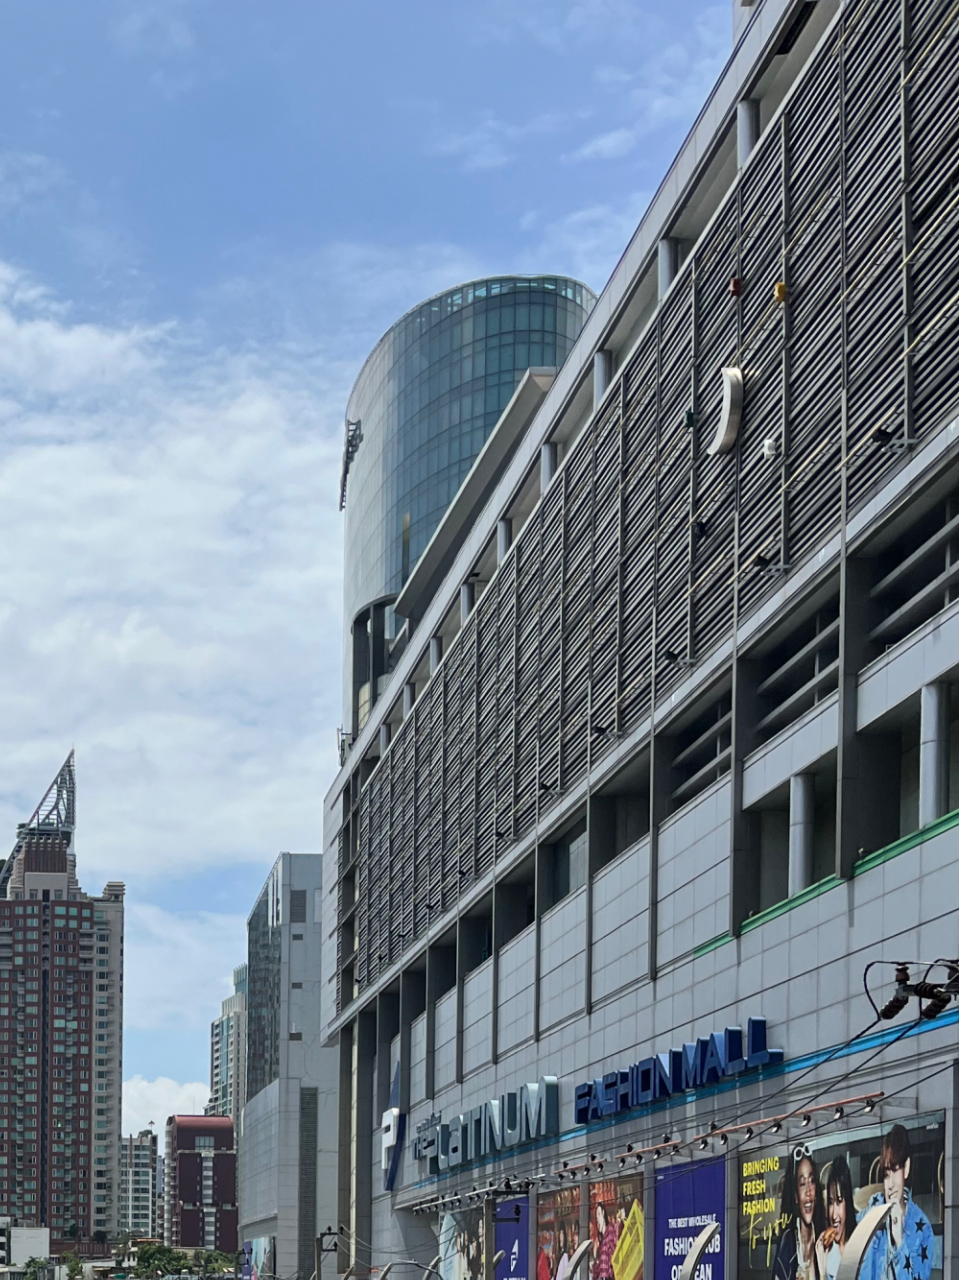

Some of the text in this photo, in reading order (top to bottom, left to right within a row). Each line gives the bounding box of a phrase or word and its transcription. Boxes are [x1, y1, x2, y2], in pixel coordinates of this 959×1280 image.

[574, 1016, 784, 1125] FASHION MALL
[742, 1156, 780, 1177] BRINGING
[742, 1179, 767, 1196] FRESH
[742, 1197, 776, 1216] FASHION
[668, 1213, 717, 1229] THE BEST WHOLESALE
[664, 1236, 697, 1256] FASHIO
